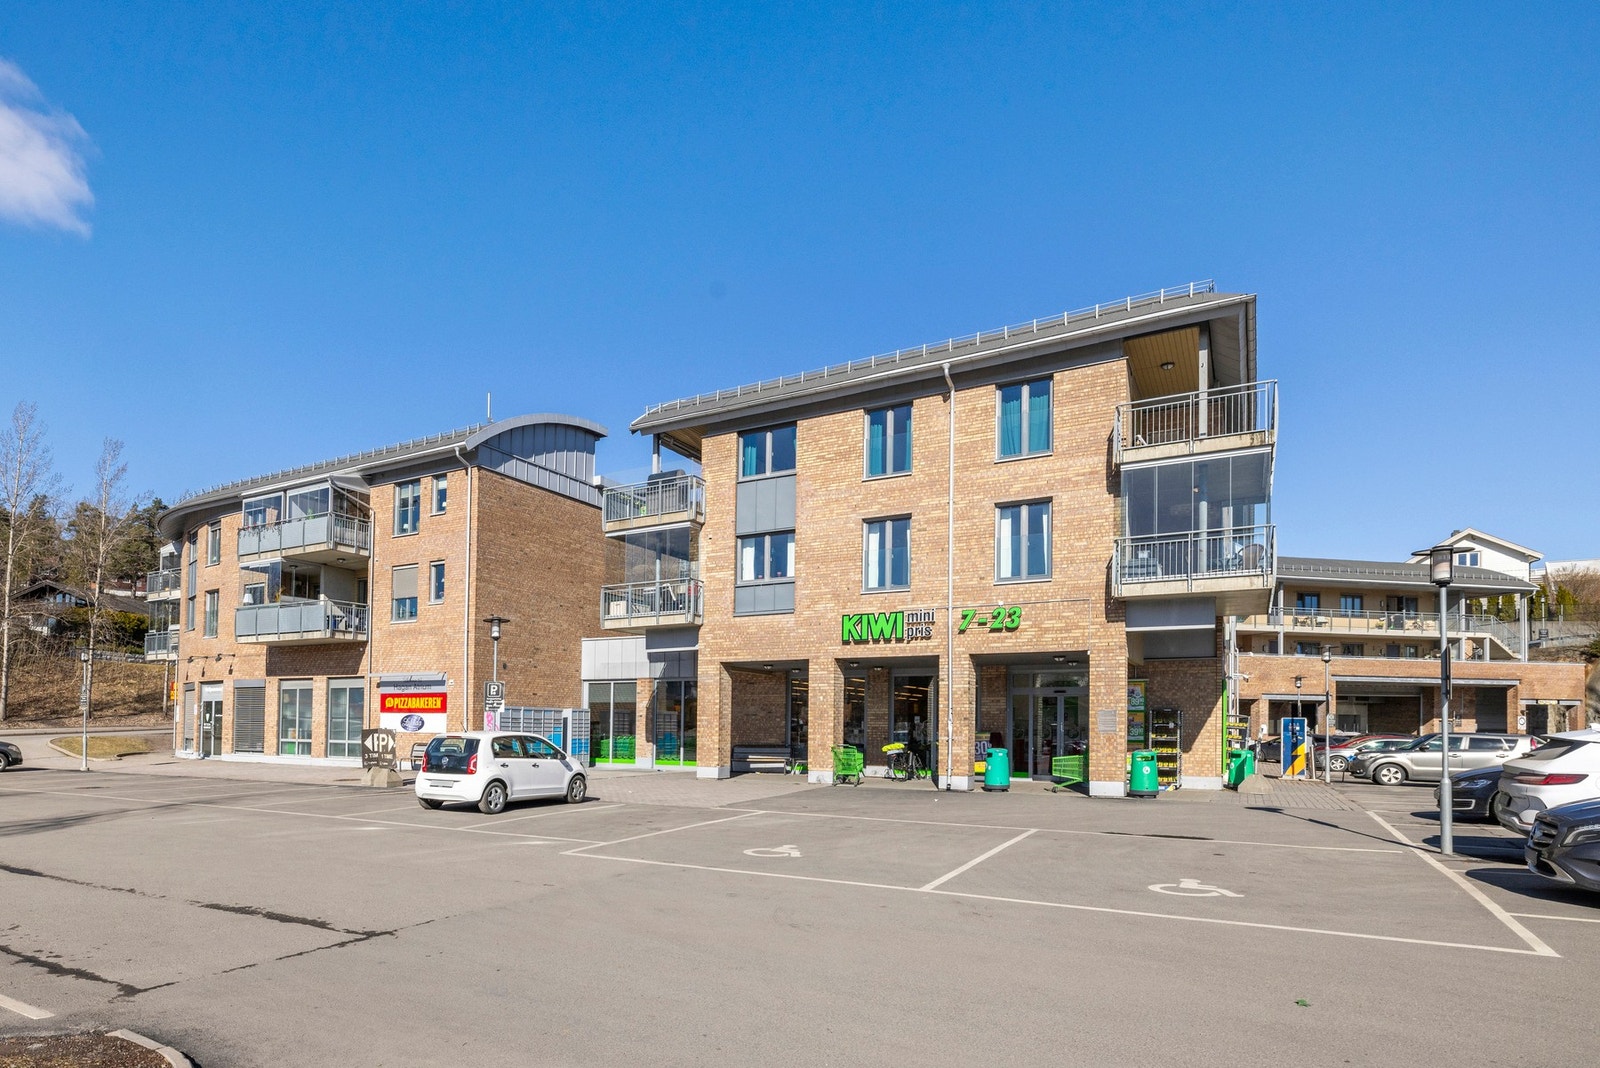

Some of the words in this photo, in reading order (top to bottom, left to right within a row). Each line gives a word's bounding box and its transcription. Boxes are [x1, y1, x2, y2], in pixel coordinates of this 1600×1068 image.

[907, 609, 935, 623] mini
[842, 611, 904, 641] KIWI
[907, 624, 933, 640] pris
[393, 697, 442, 709] PIZZABAKEREN
[379, 733, 388, 752] P
